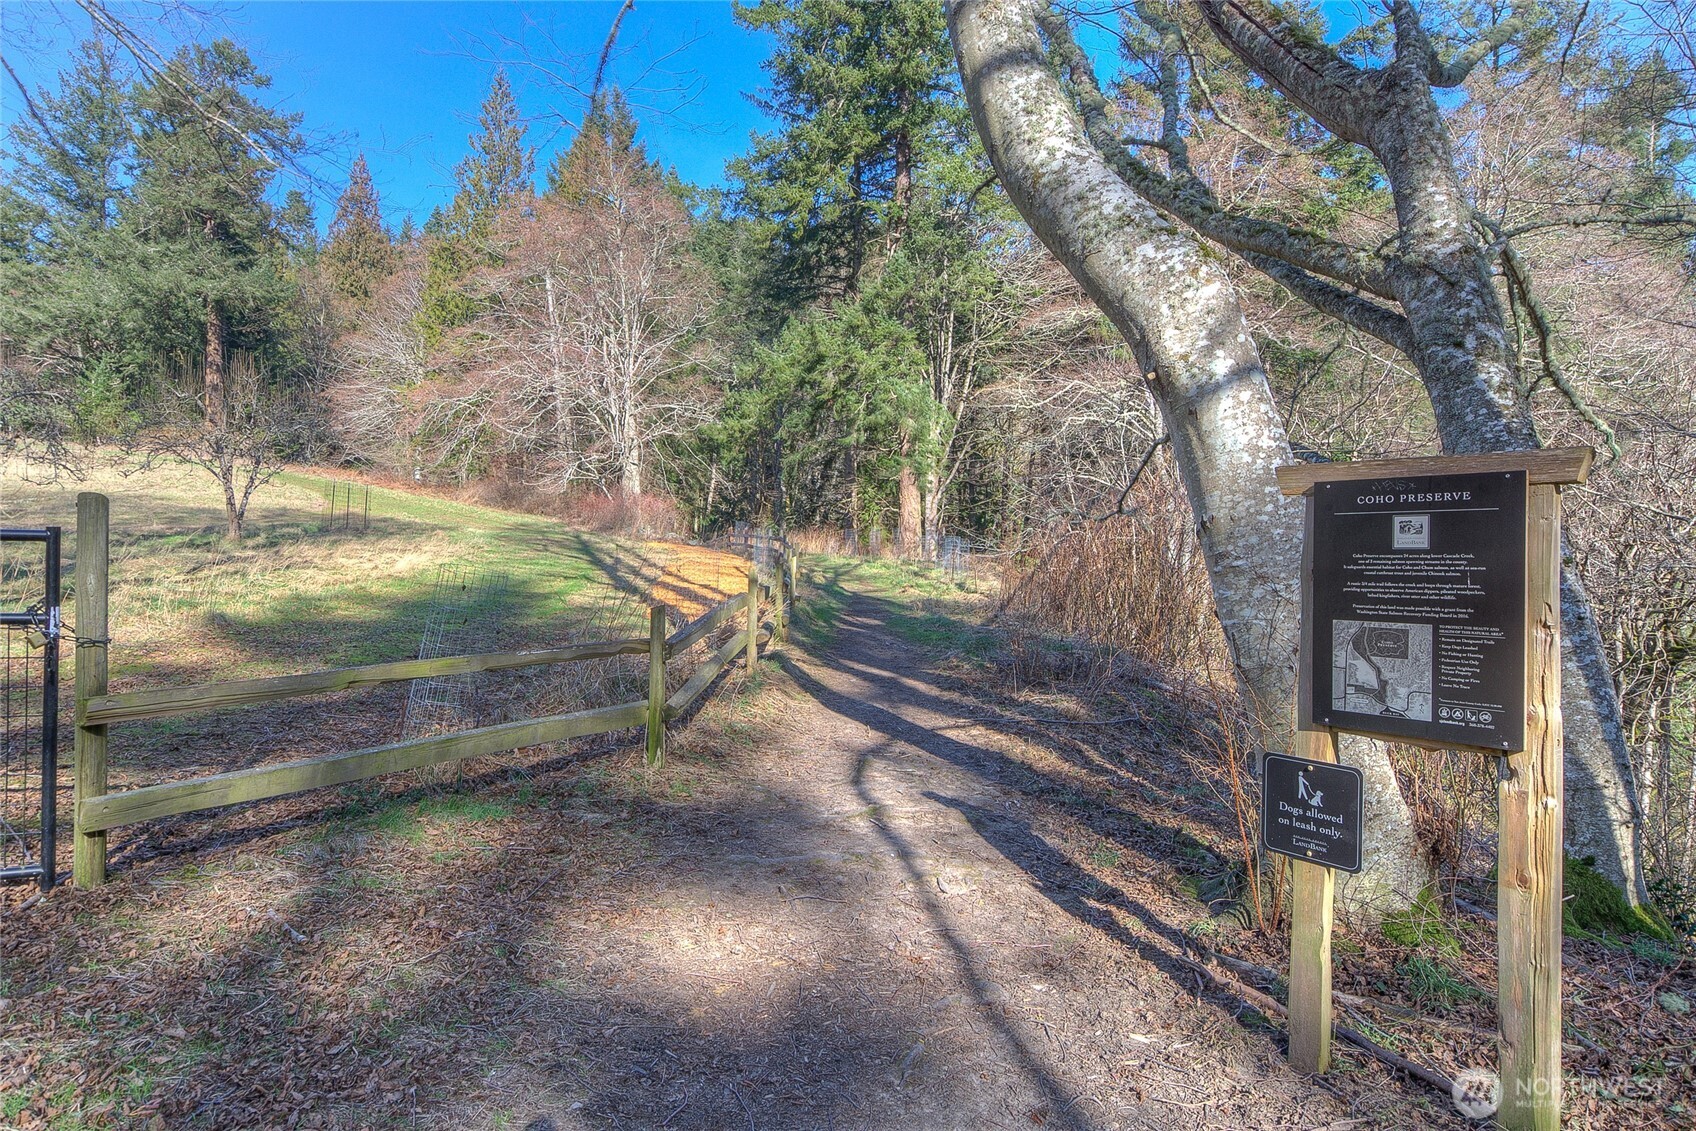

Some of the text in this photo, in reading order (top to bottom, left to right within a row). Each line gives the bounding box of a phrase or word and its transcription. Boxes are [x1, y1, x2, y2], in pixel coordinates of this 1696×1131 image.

[1357, 492, 1472, 504] COHO PRESERVE
[1279, 801, 1343, 824] Dogs allowed
[1293, 817, 1316, 831] leash
[1319, 826, 1343, 839] only.
